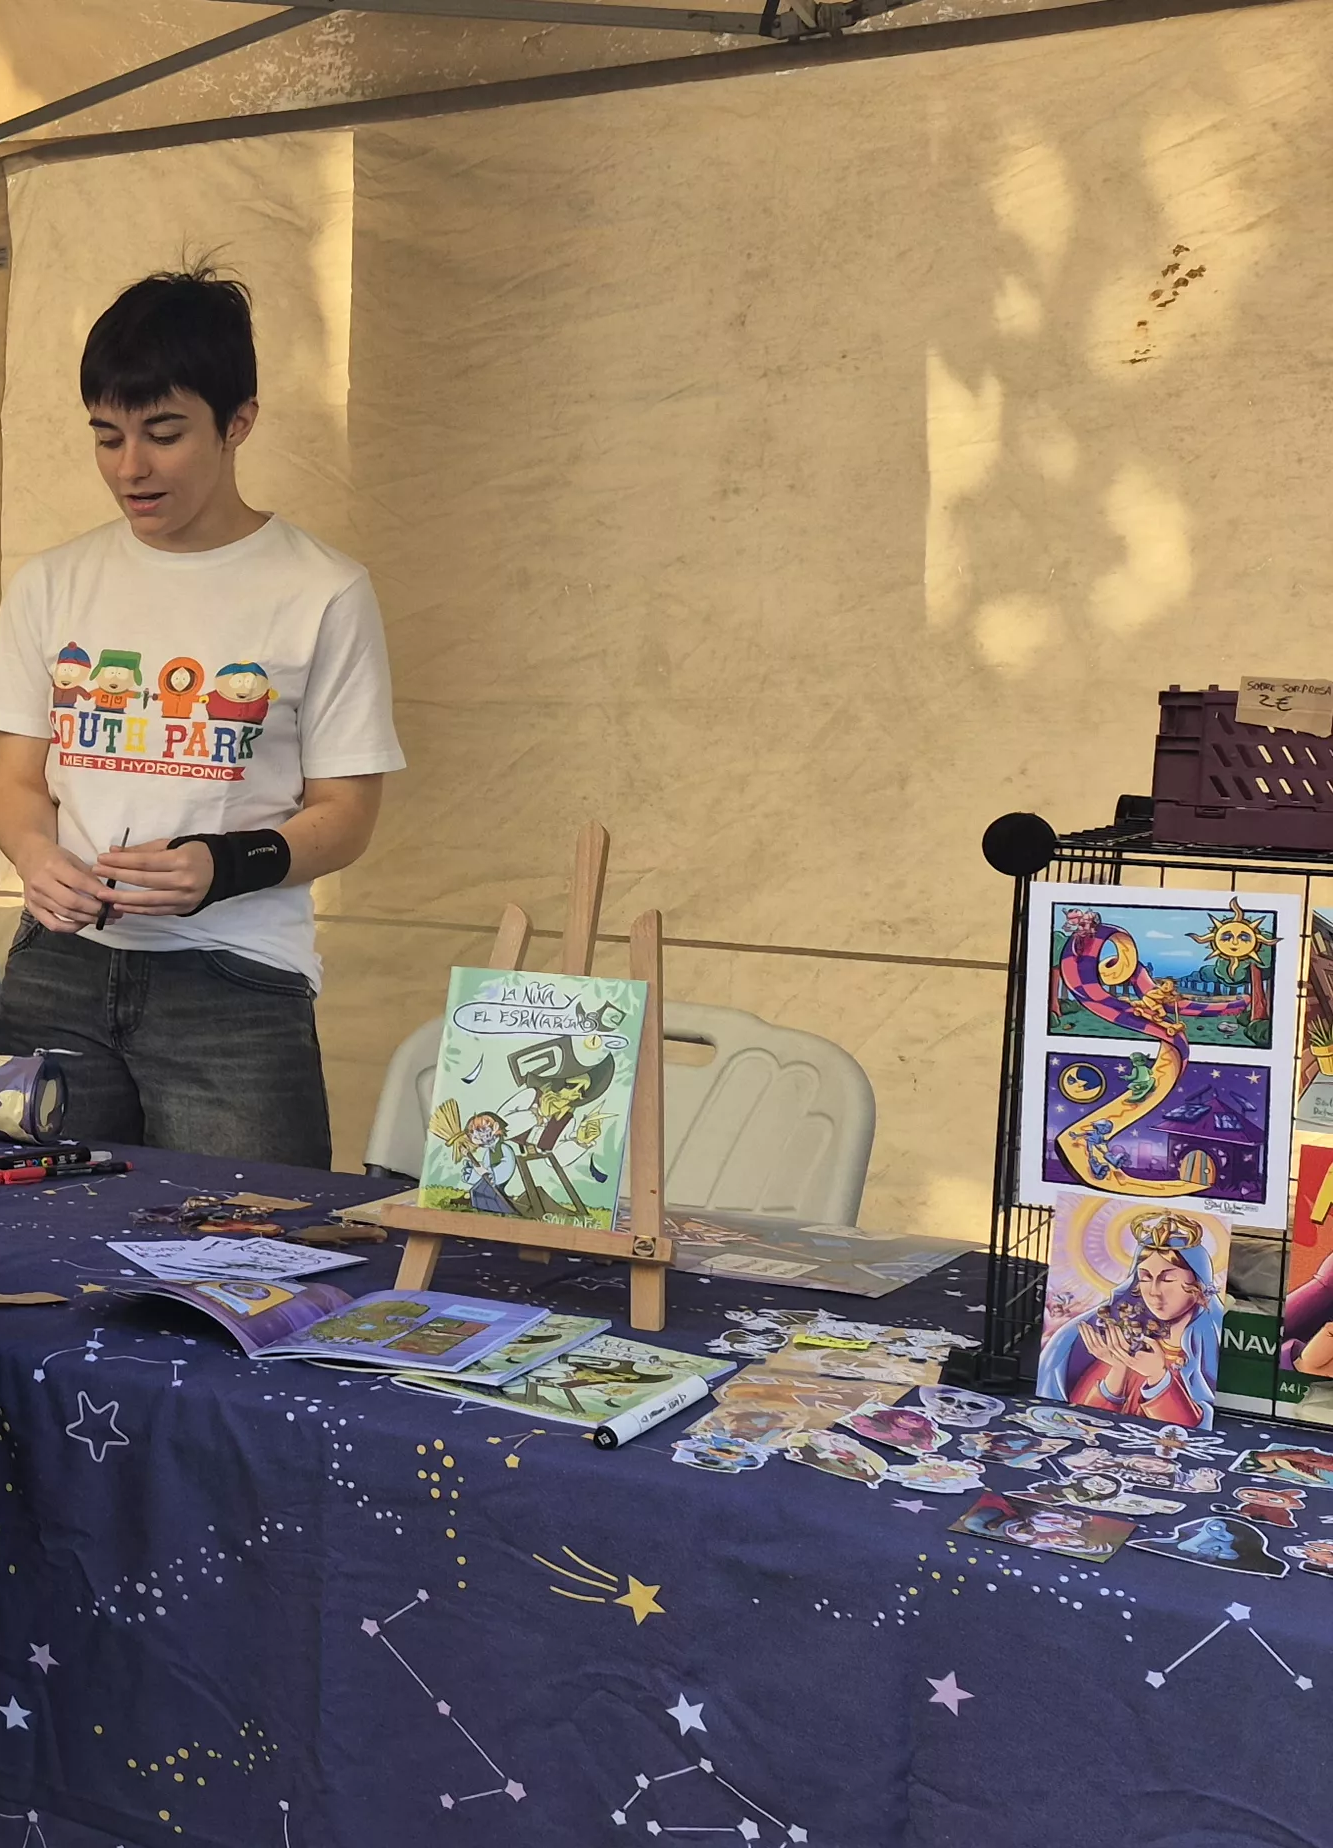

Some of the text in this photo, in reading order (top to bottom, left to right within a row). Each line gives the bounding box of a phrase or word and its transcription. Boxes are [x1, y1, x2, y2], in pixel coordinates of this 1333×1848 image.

[1247, 680, 1276, 692] SOBRE
[50, 710, 265, 764] SOUTH PARK
[62, 754, 235, 780] MEETS HYDROPONIC
[474, 1010, 493, 1023] EL
